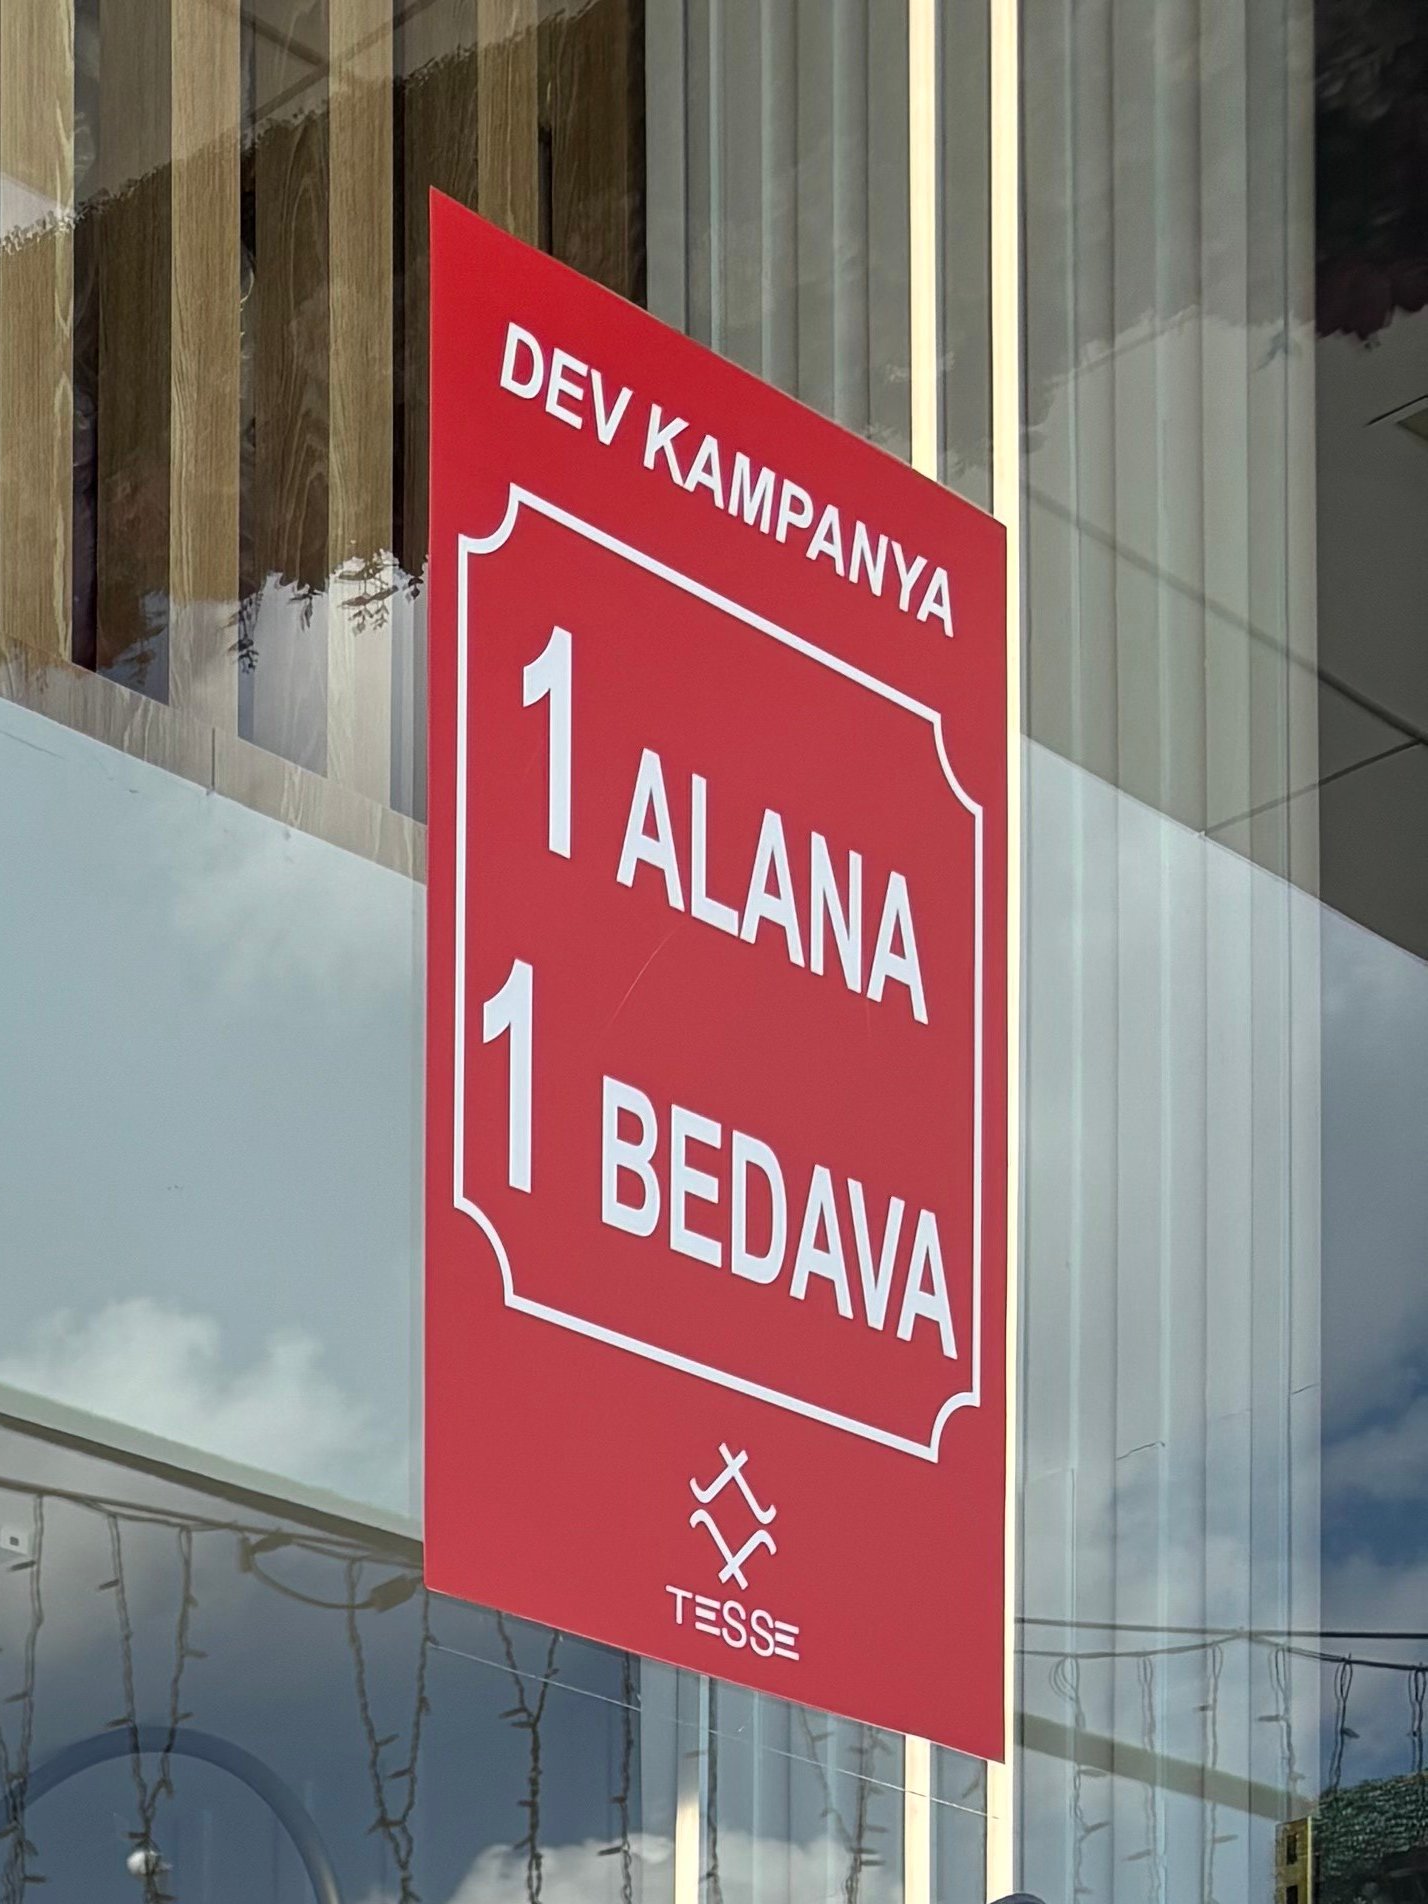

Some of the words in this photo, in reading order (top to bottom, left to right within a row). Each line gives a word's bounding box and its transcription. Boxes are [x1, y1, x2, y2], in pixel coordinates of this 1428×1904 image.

[499, 321, 634, 447] DEV
[643, 402, 955, 639] KAMPANYA
[521, 624, 573, 860] 1
[615, 746, 930, 1026] ALANA
[481, 957, 535, 1195] 1
[601, 1073, 959, 1361] BEDAVA
[664, 1584, 801, 1661] TESSE
